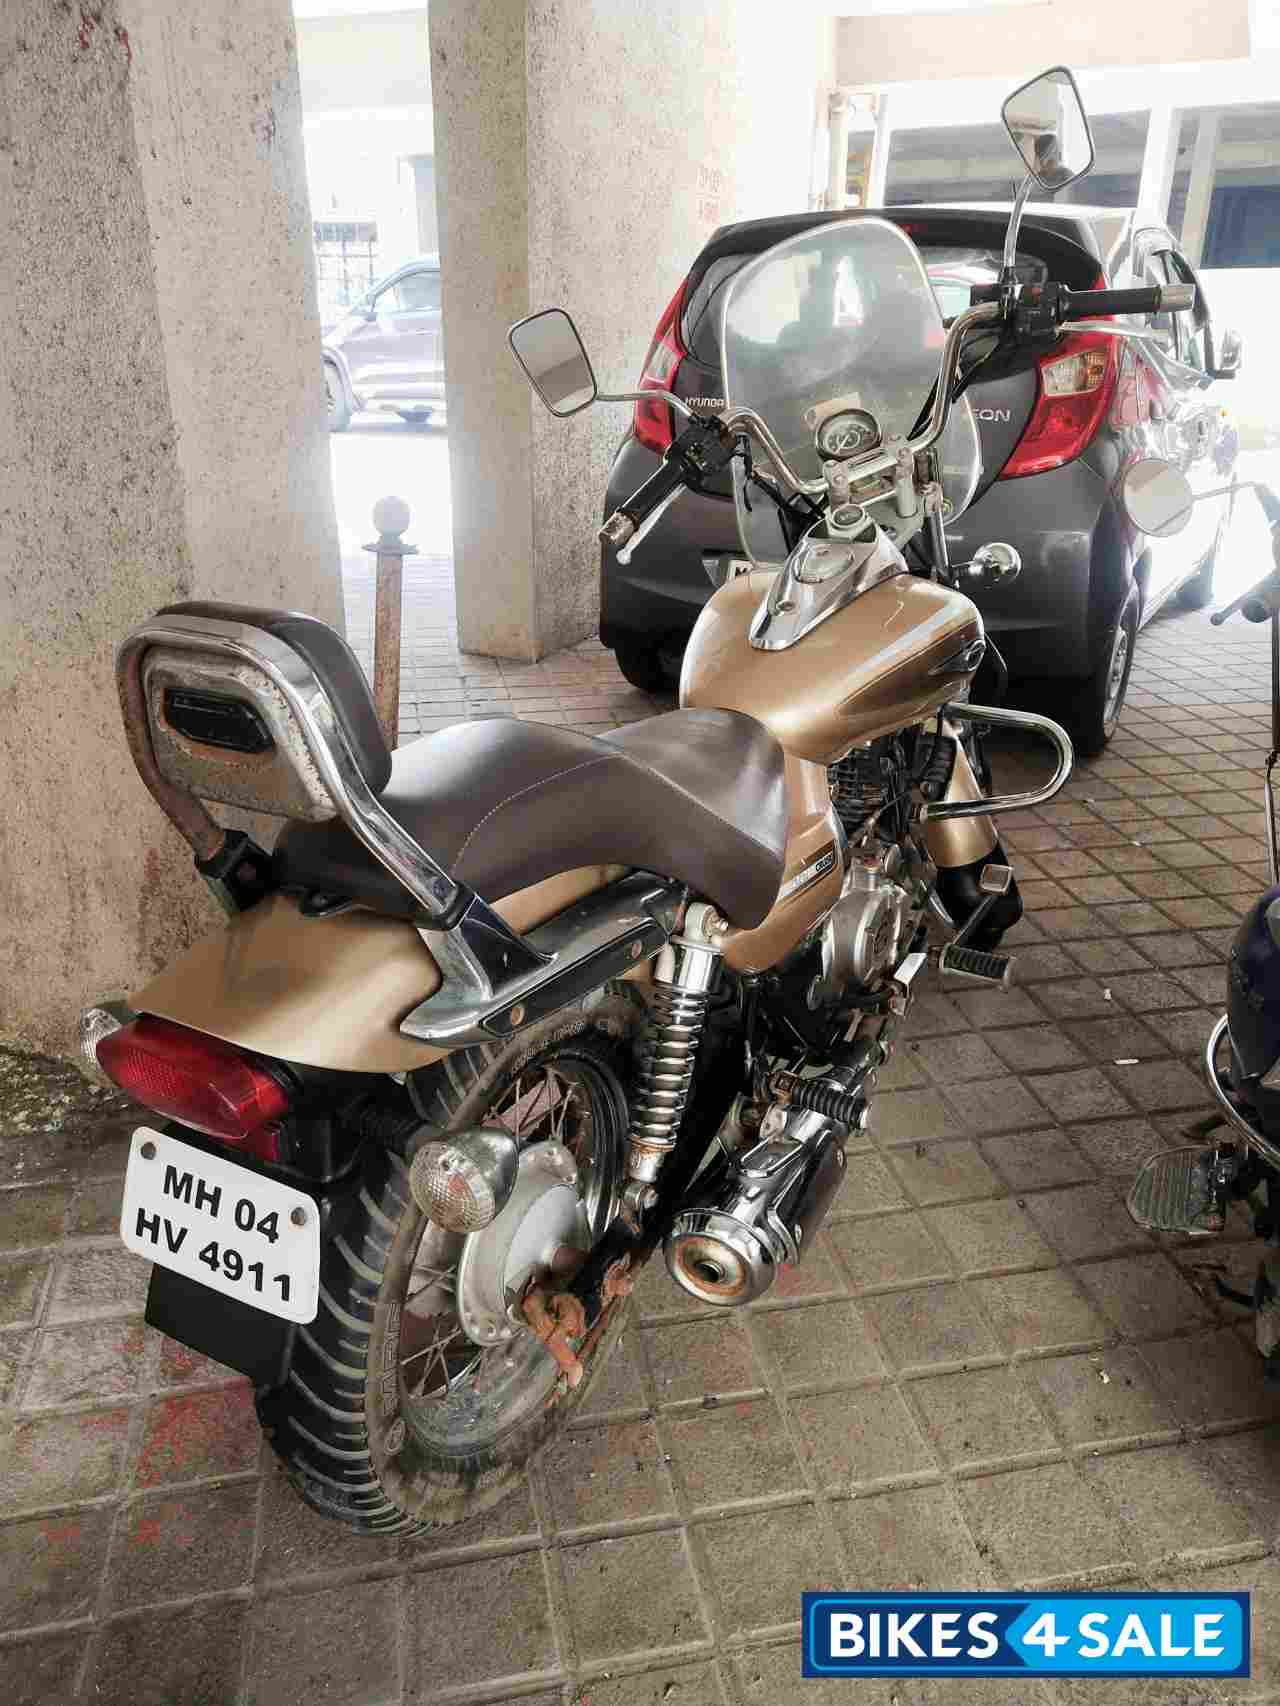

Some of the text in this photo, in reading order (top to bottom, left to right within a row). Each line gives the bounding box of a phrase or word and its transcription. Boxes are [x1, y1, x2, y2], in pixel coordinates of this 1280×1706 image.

[163, 1165, 280, 1244] MH 04
[135, 1207, 291, 1302] HV 4911
